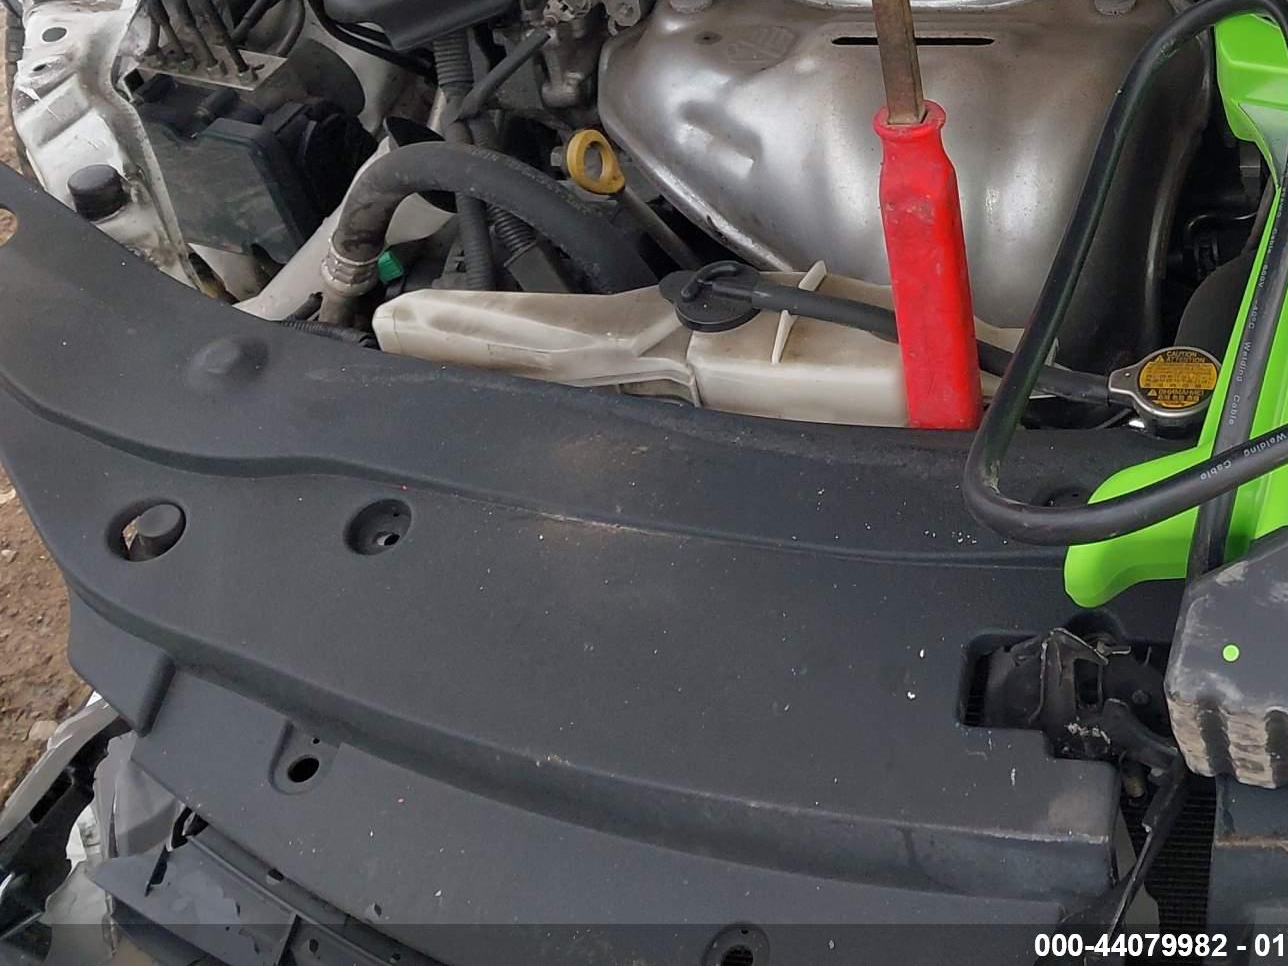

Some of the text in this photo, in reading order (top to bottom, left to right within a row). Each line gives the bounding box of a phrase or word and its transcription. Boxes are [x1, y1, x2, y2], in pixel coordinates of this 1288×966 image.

[1236, 341, 1252, 382] Welding
[1228, 394, 1241, 425] Cable
[1243, 433, 1287, 457] Welding
[1200, 459, 1232, 480] Cable
